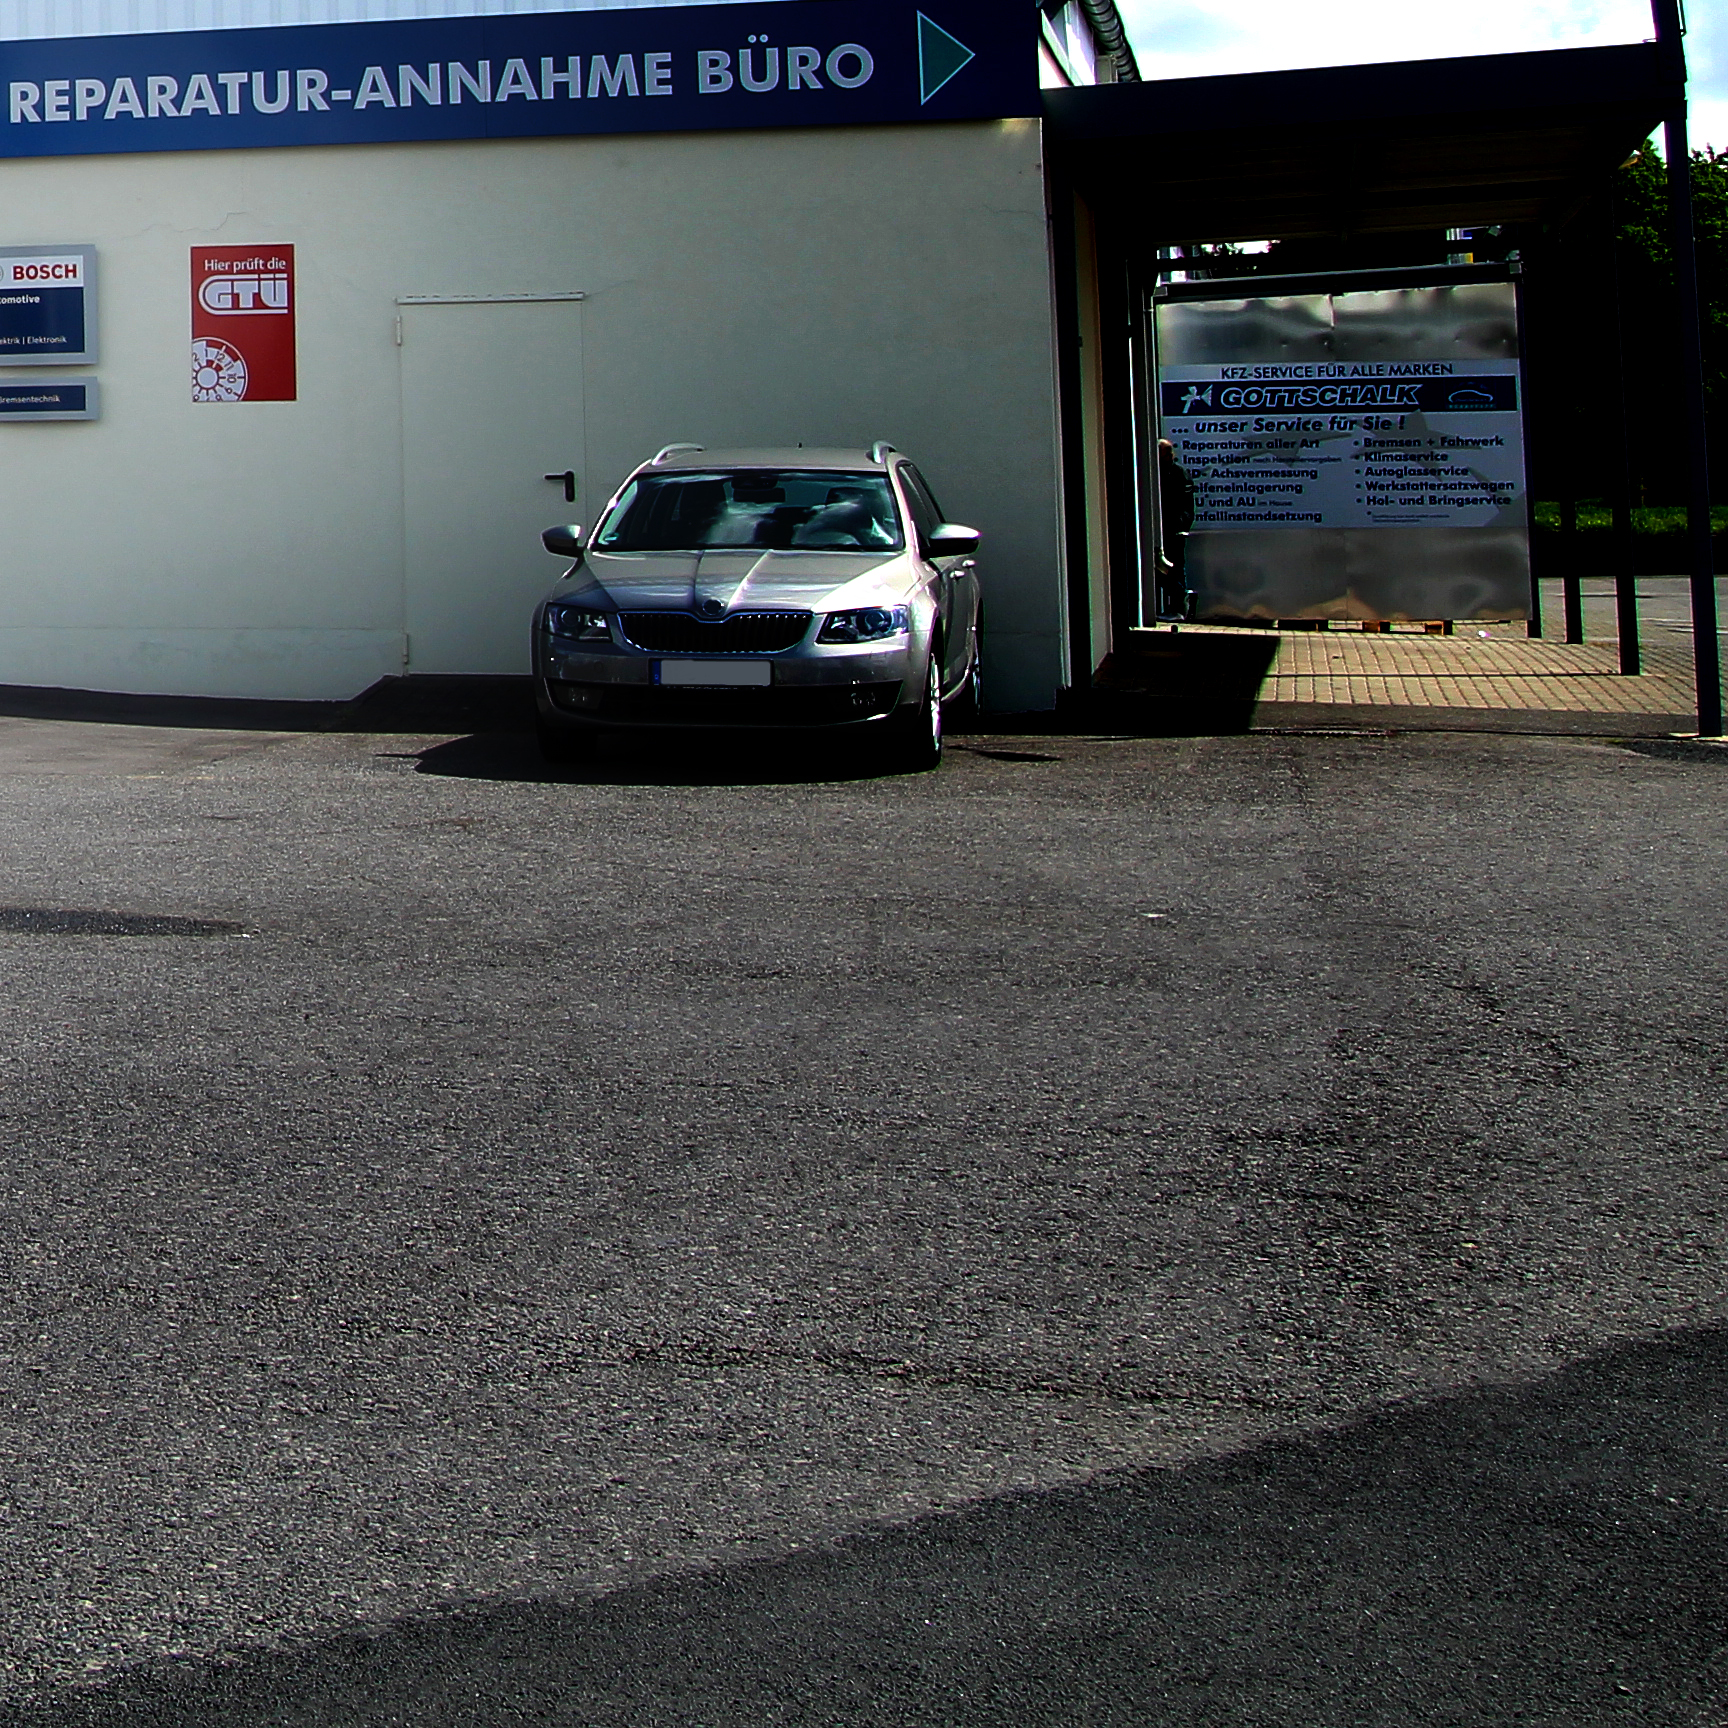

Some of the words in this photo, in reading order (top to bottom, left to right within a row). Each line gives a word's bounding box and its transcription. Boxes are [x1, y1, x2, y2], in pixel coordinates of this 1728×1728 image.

[8, 51, 673, 124] REPARATUR-ANNAHME
[697, 33, 875, 94] BÜRO
[204, 259, 231, 271] Hier
[233, 256, 264, 273] prüft
[267, 256, 286, 269] die
[12, 263, 77, 281] BOSCH
[199, 273, 288, 314] GTÜ
[27, 335, 67, 345] Elektronik
[1221, 365, 1313, 380] KFZ-SERVICE
[1317, 362, 1345, 377] FÜR
[1350, 364, 1384, 377] ALLE
[1389, 363, 1453, 376] MARKEN
[1220, 384, 1423, 408] GOTTSCHALK
[1195, 421, 1248, 433] unser
[1253, 417, 1323, 432] Service
[1329, 416, 1357, 431] für
[1363, 416, 1392, 431] Sie
[1182, 440, 1262, 452] Reparaturen
[1266, 439, 1294, 449] aller
[1299, 439, 1320, 448] Art
[1364, 438, 1421, 448] Bremsen
[1440, 435, 1504, 447] Fahrwerk
[1183, 454, 1250, 466] Inspektion
[1364, 452, 1449, 462] Klimaservice
[1211, 468, 1318, 480] Achsvermessung
[1364, 466, 1469, 478] Autoglasservice
[1193, 482, 1303, 494] eifeneinlagerung
[1365, 480, 1514, 492] Werkstattersatzwagen
[1209, 496, 1232, 507] und
[1237, 497, 1256, 507] AU
[1366, 495, 1395, 505] Hol-
[1399, 495, 1424, 505] und
[1429, 495, 1512, 507] Bringservice
[1195, 511, 1322, 522] nfallinstandsetzung
